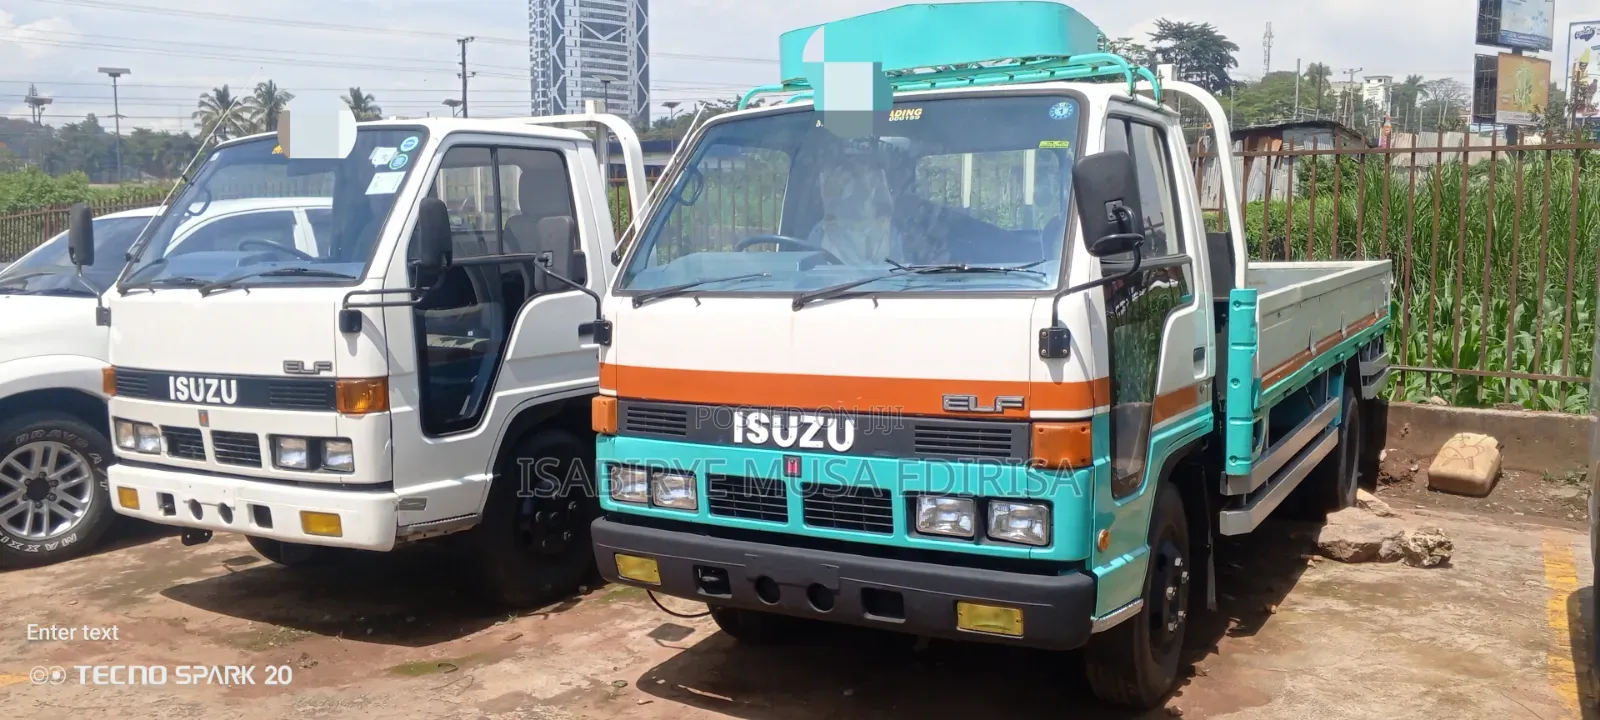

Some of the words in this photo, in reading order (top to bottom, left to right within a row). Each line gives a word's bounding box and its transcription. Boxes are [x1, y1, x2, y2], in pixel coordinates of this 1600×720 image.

[283, 360, 333, 375] ELF
[168, 376, 237, 404] ISUZU
[942, 394, 1024, 414] ELF
[16, 429, 89, 448] BRAVO
[733, 411, 855, 452] ISUZU
